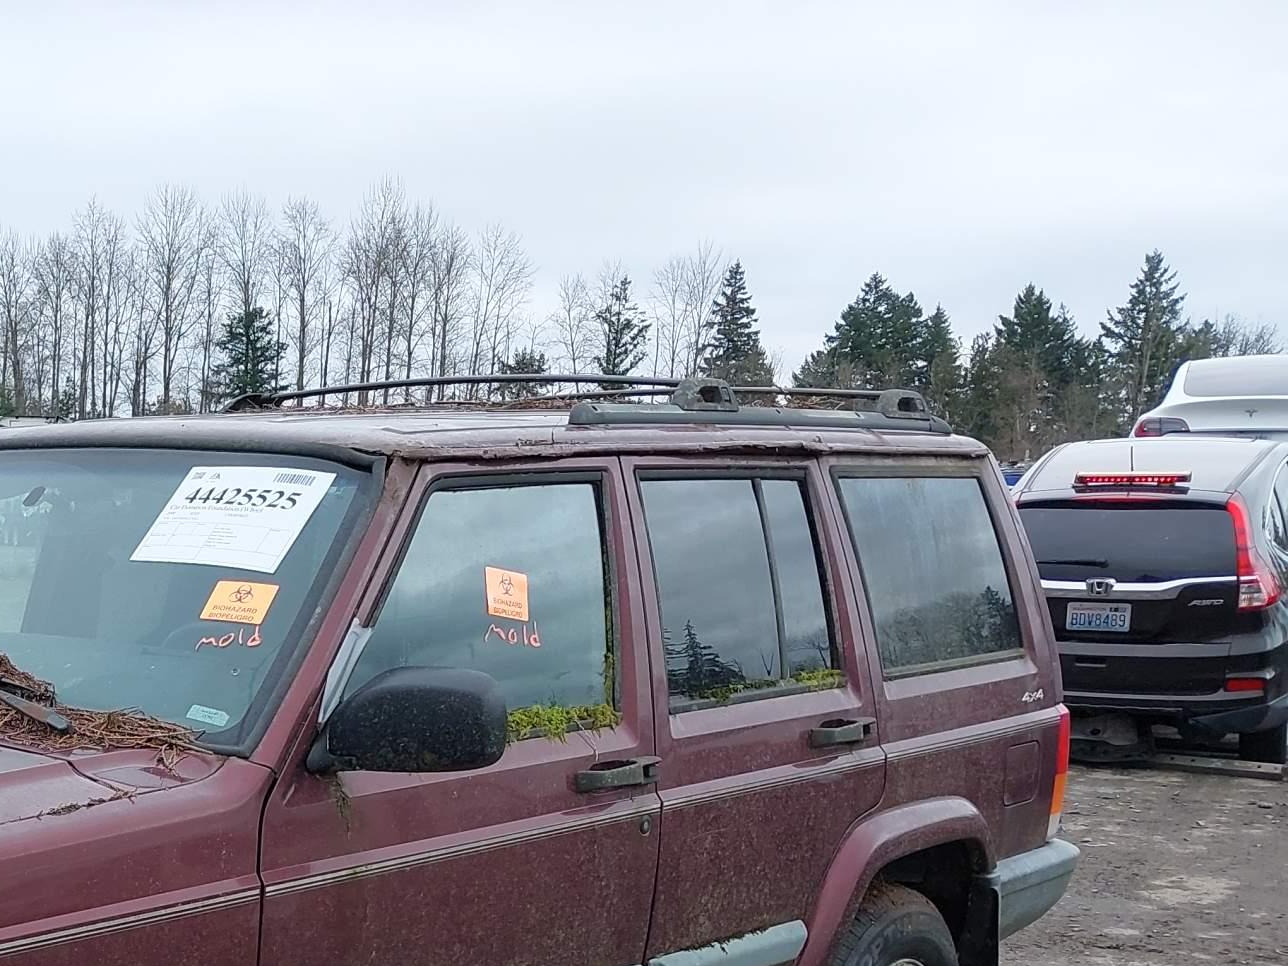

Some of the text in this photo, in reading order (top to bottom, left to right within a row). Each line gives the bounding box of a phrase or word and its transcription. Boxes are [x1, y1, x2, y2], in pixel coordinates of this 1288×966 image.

[185, 487, 303, 510] 44425525
[212, 604, 258, 614] BIOHAZARD
[1071, 612, 1126, 627] BDV8489
[195, 625, 262, 651] mold
[484, 620, 542, 648] mold
